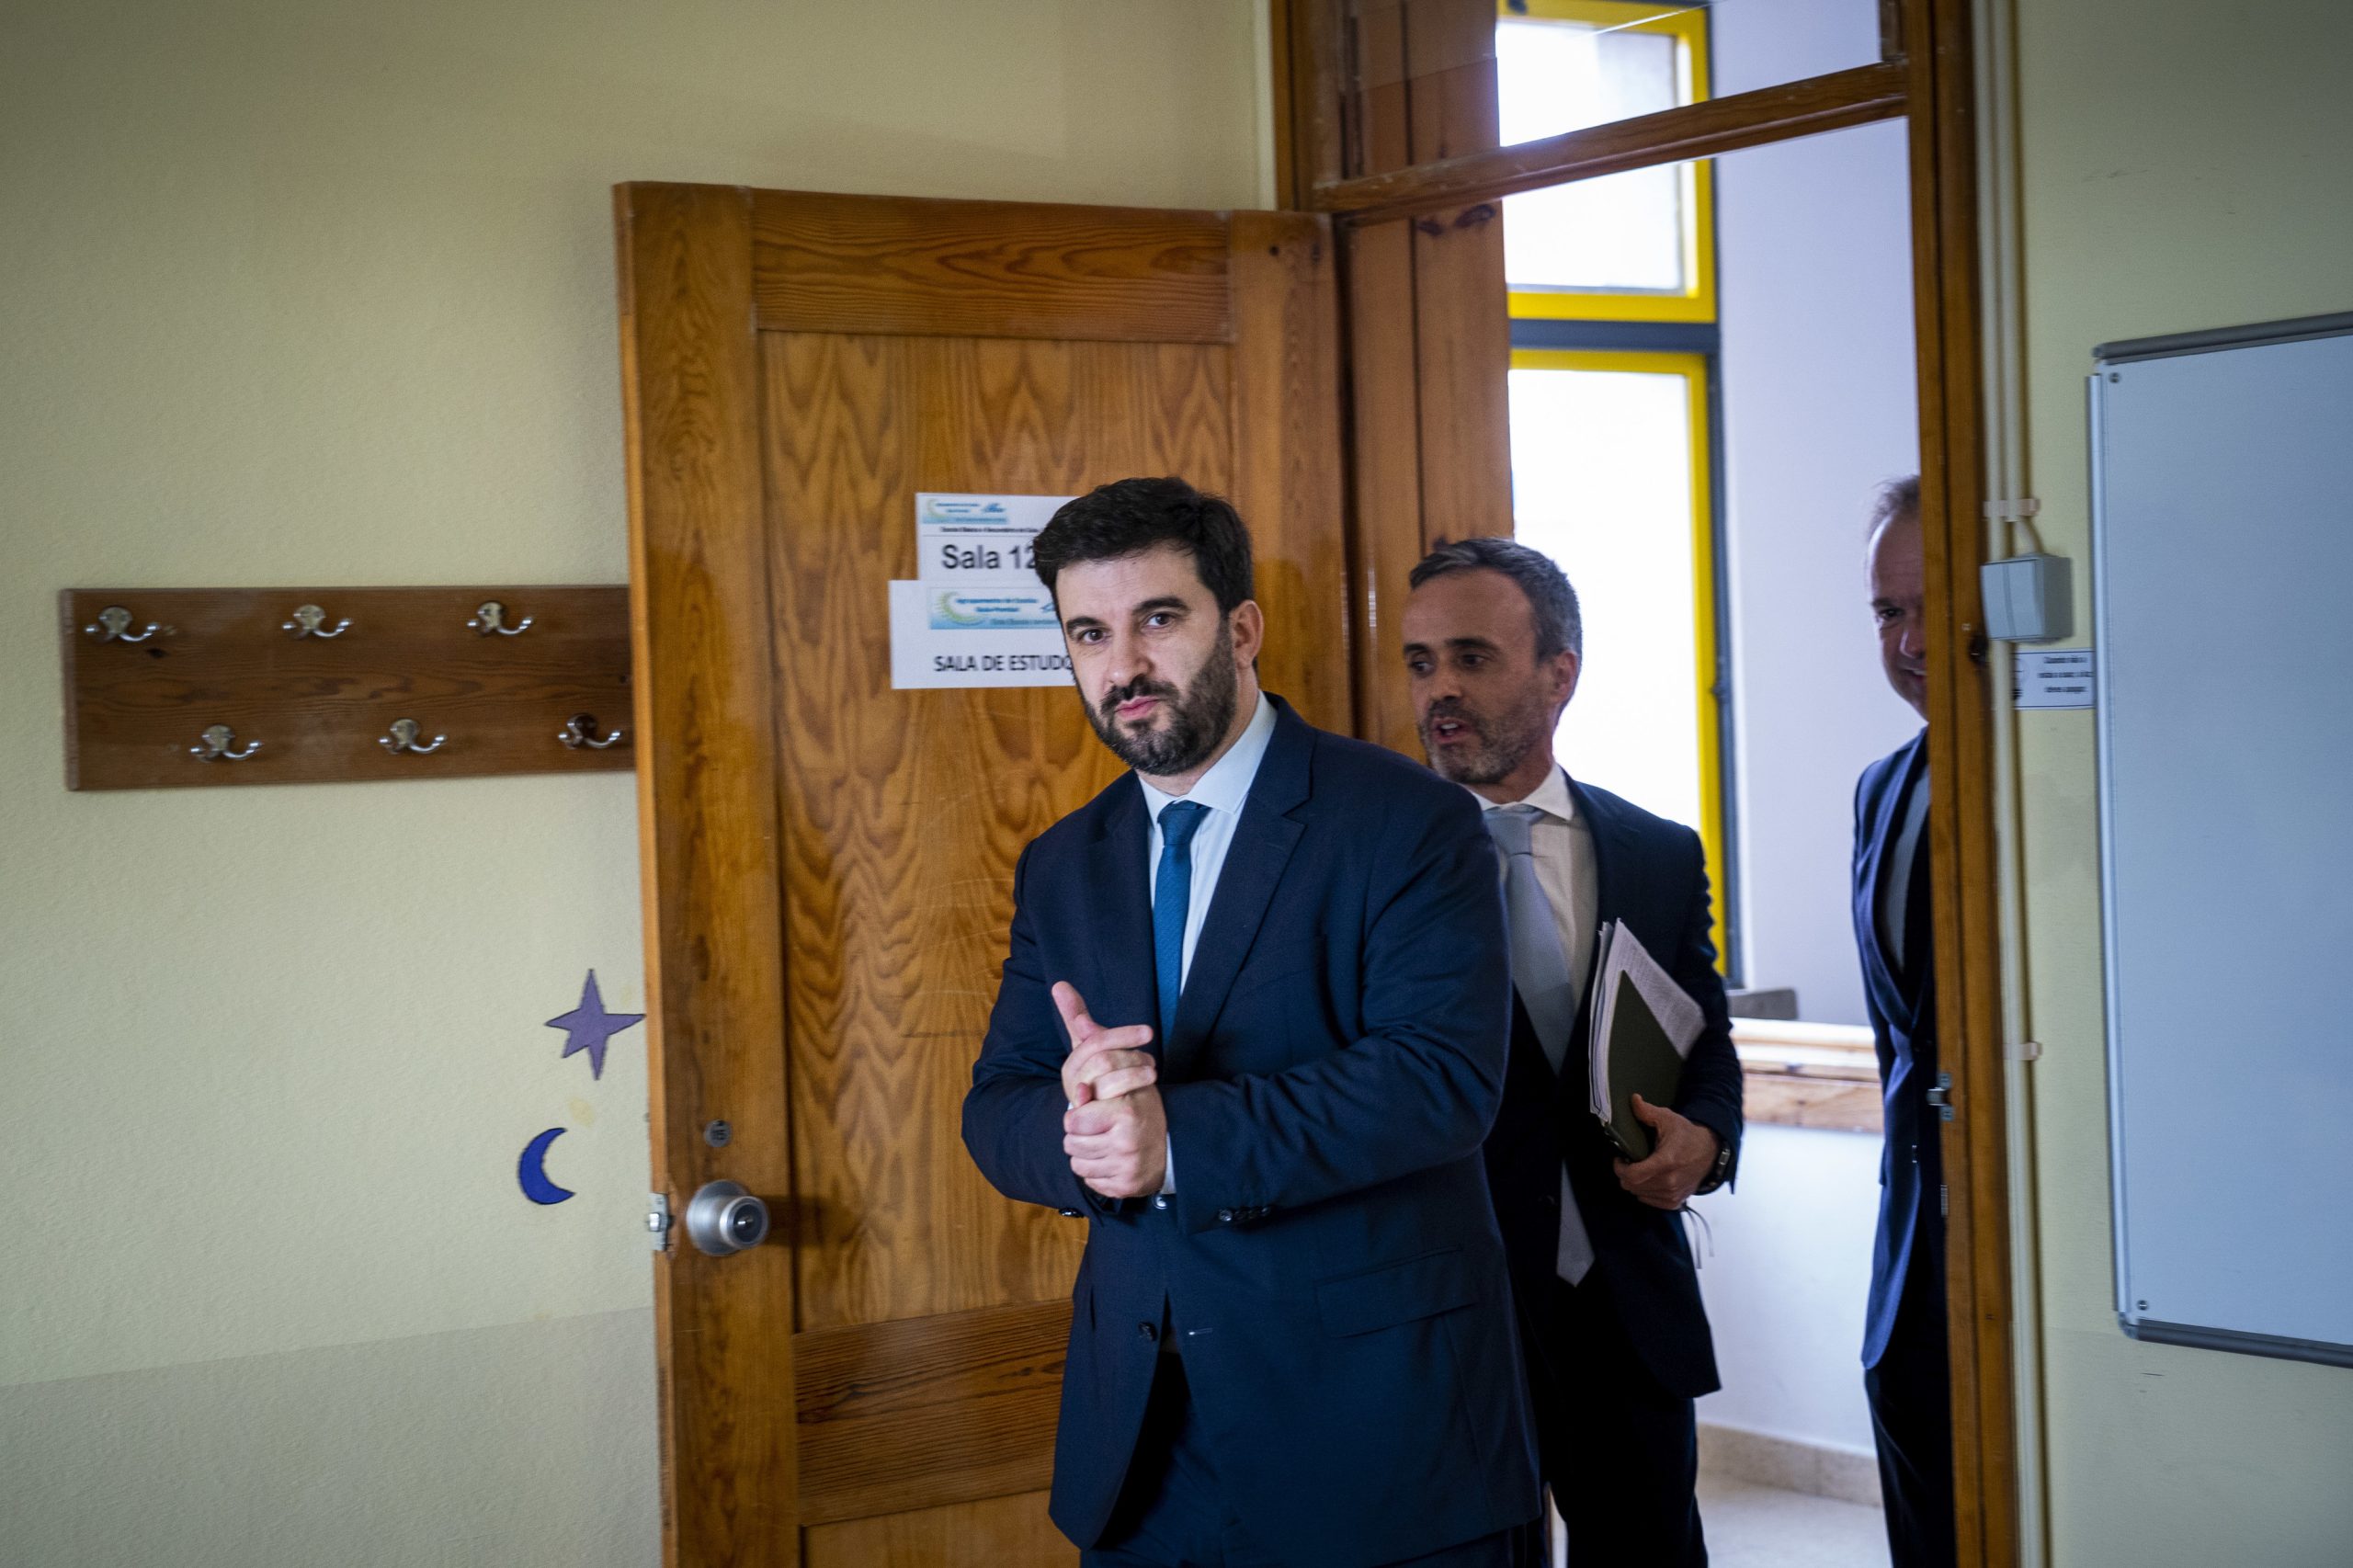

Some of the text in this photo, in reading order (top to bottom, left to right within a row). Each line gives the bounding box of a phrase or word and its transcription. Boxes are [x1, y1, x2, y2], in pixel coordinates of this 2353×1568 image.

[941, 544, 999, 569] Sala
[934, 656, 977, 672] SALA
[983, 655, 1004, 671] DE
